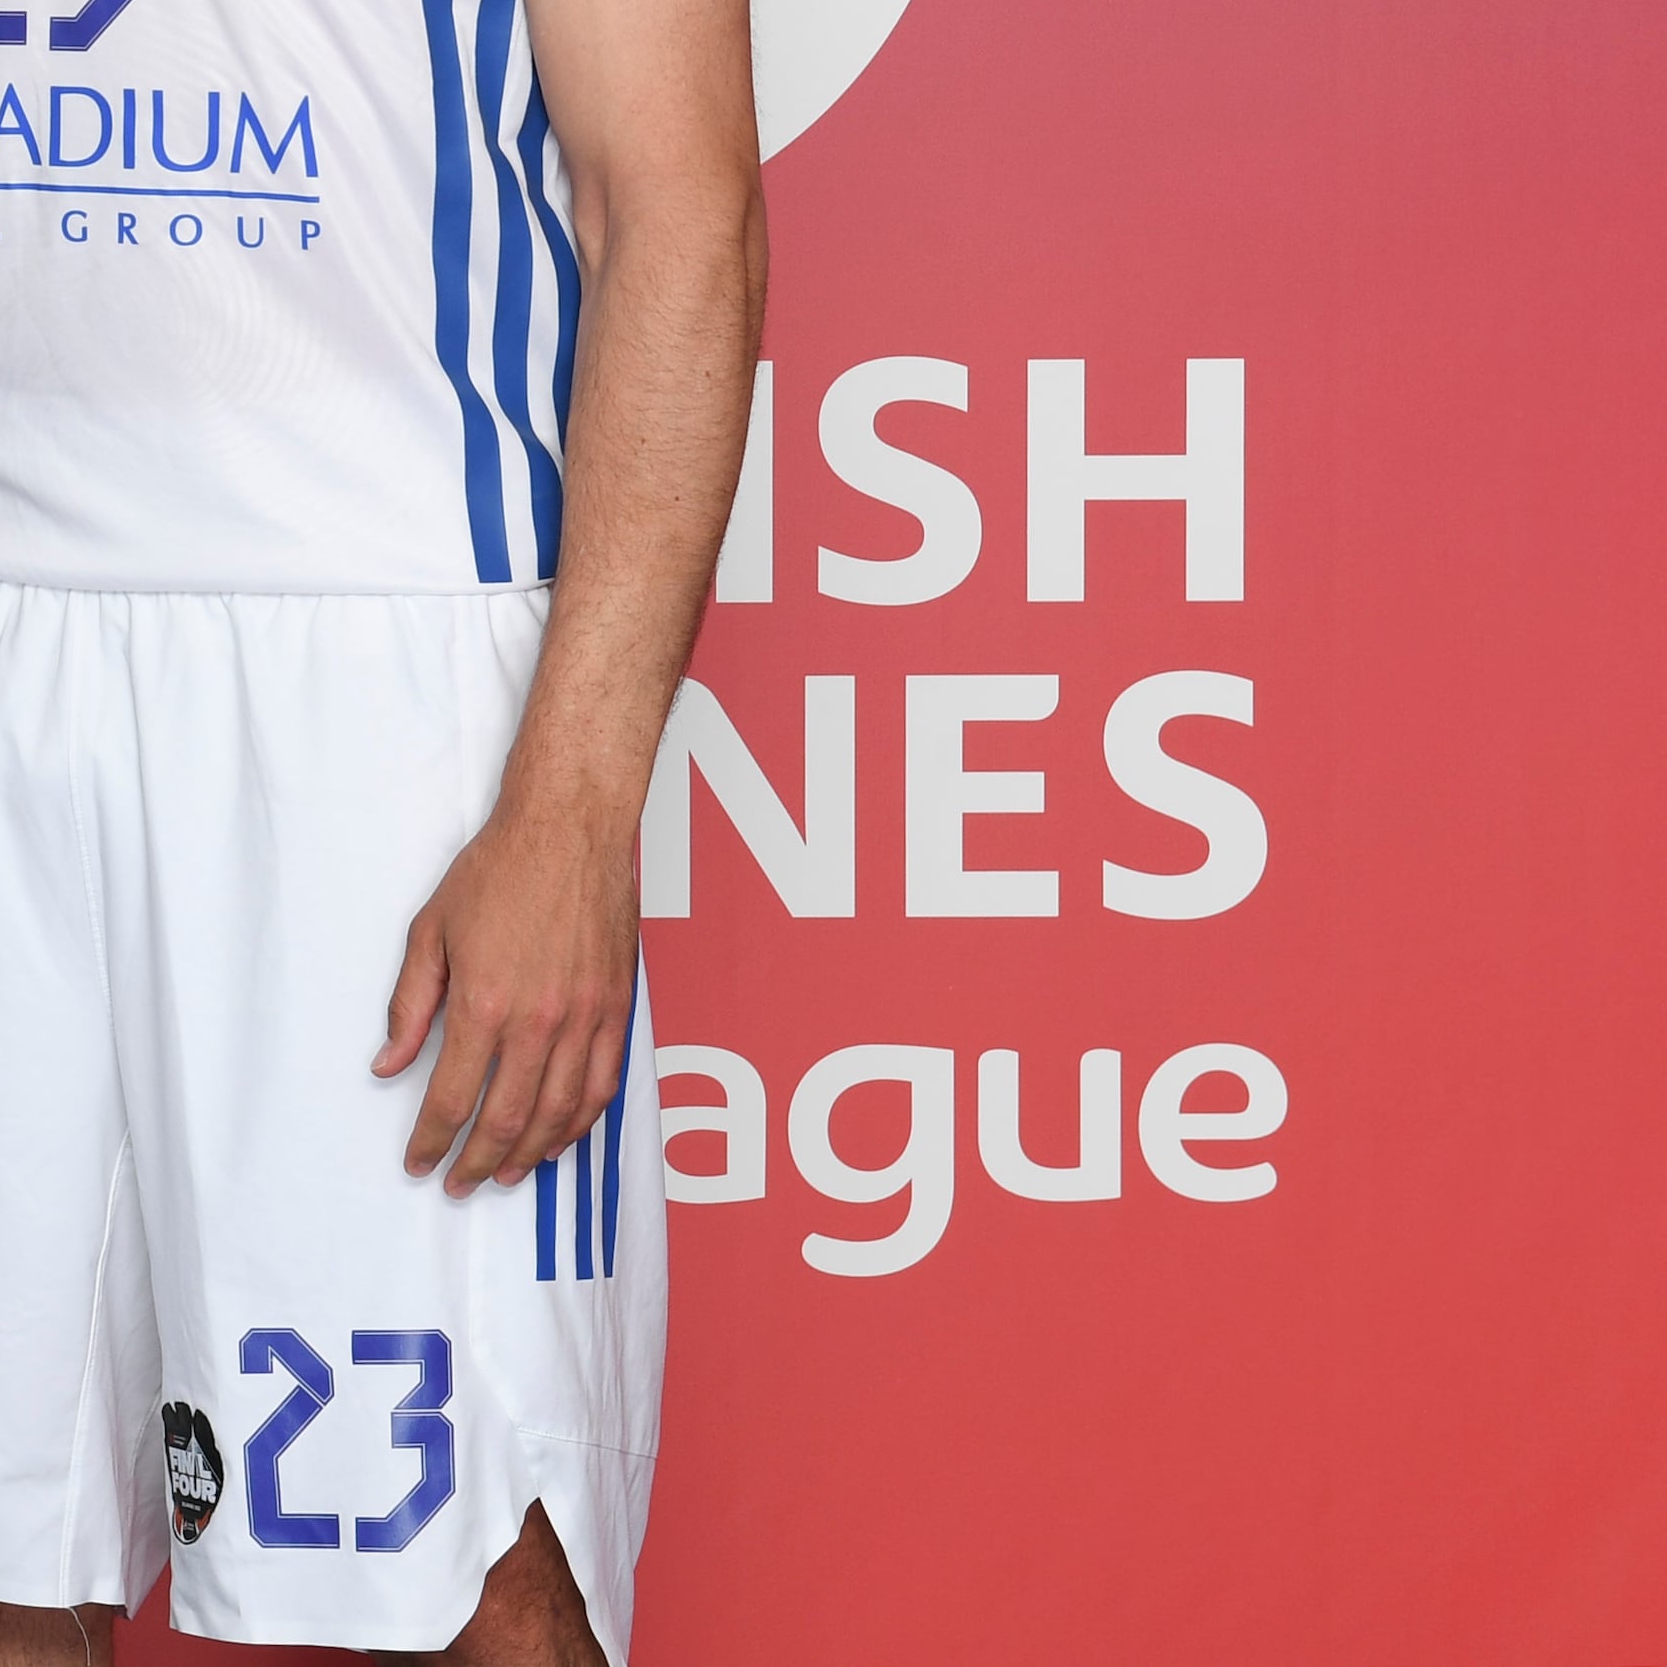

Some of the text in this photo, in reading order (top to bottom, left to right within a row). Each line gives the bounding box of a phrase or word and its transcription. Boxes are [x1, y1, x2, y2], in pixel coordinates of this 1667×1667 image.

[60, 209, 321, 251] GROUP
[238, 1327, 456, 1553] 23
[172, 1470, 217, 1504] FOUR
